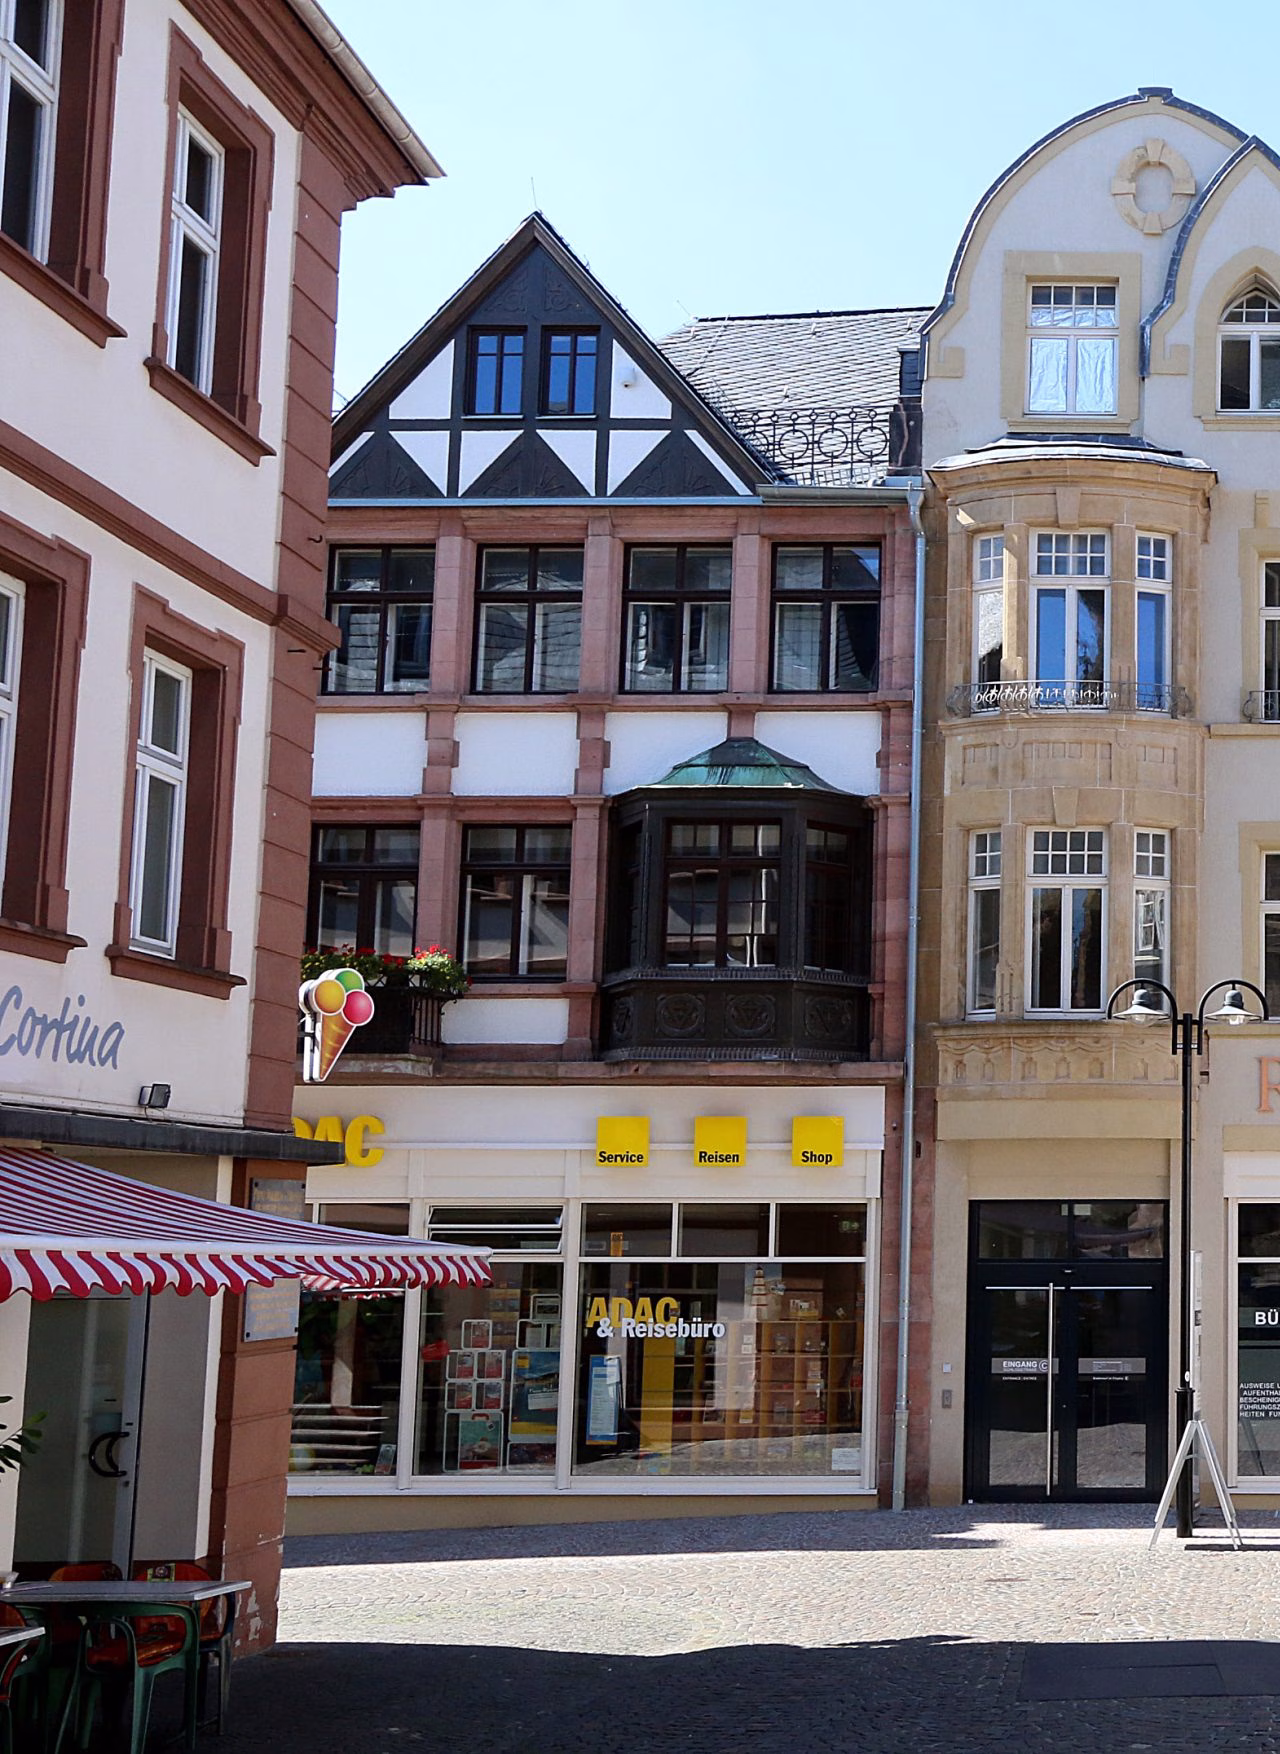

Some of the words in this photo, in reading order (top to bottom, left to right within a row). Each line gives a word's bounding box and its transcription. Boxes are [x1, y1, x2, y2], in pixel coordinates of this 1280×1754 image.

[598, 1151, 644, 1163] Service
[698, 1151, 740, 1163] Reisen
[801, 1151, 833, 1165] Shop
[586, 1297, 680, 1328] ADAC
[596, 1317, 614, 1338] &
[621, 1317, 726, 1338] Reisebüro
